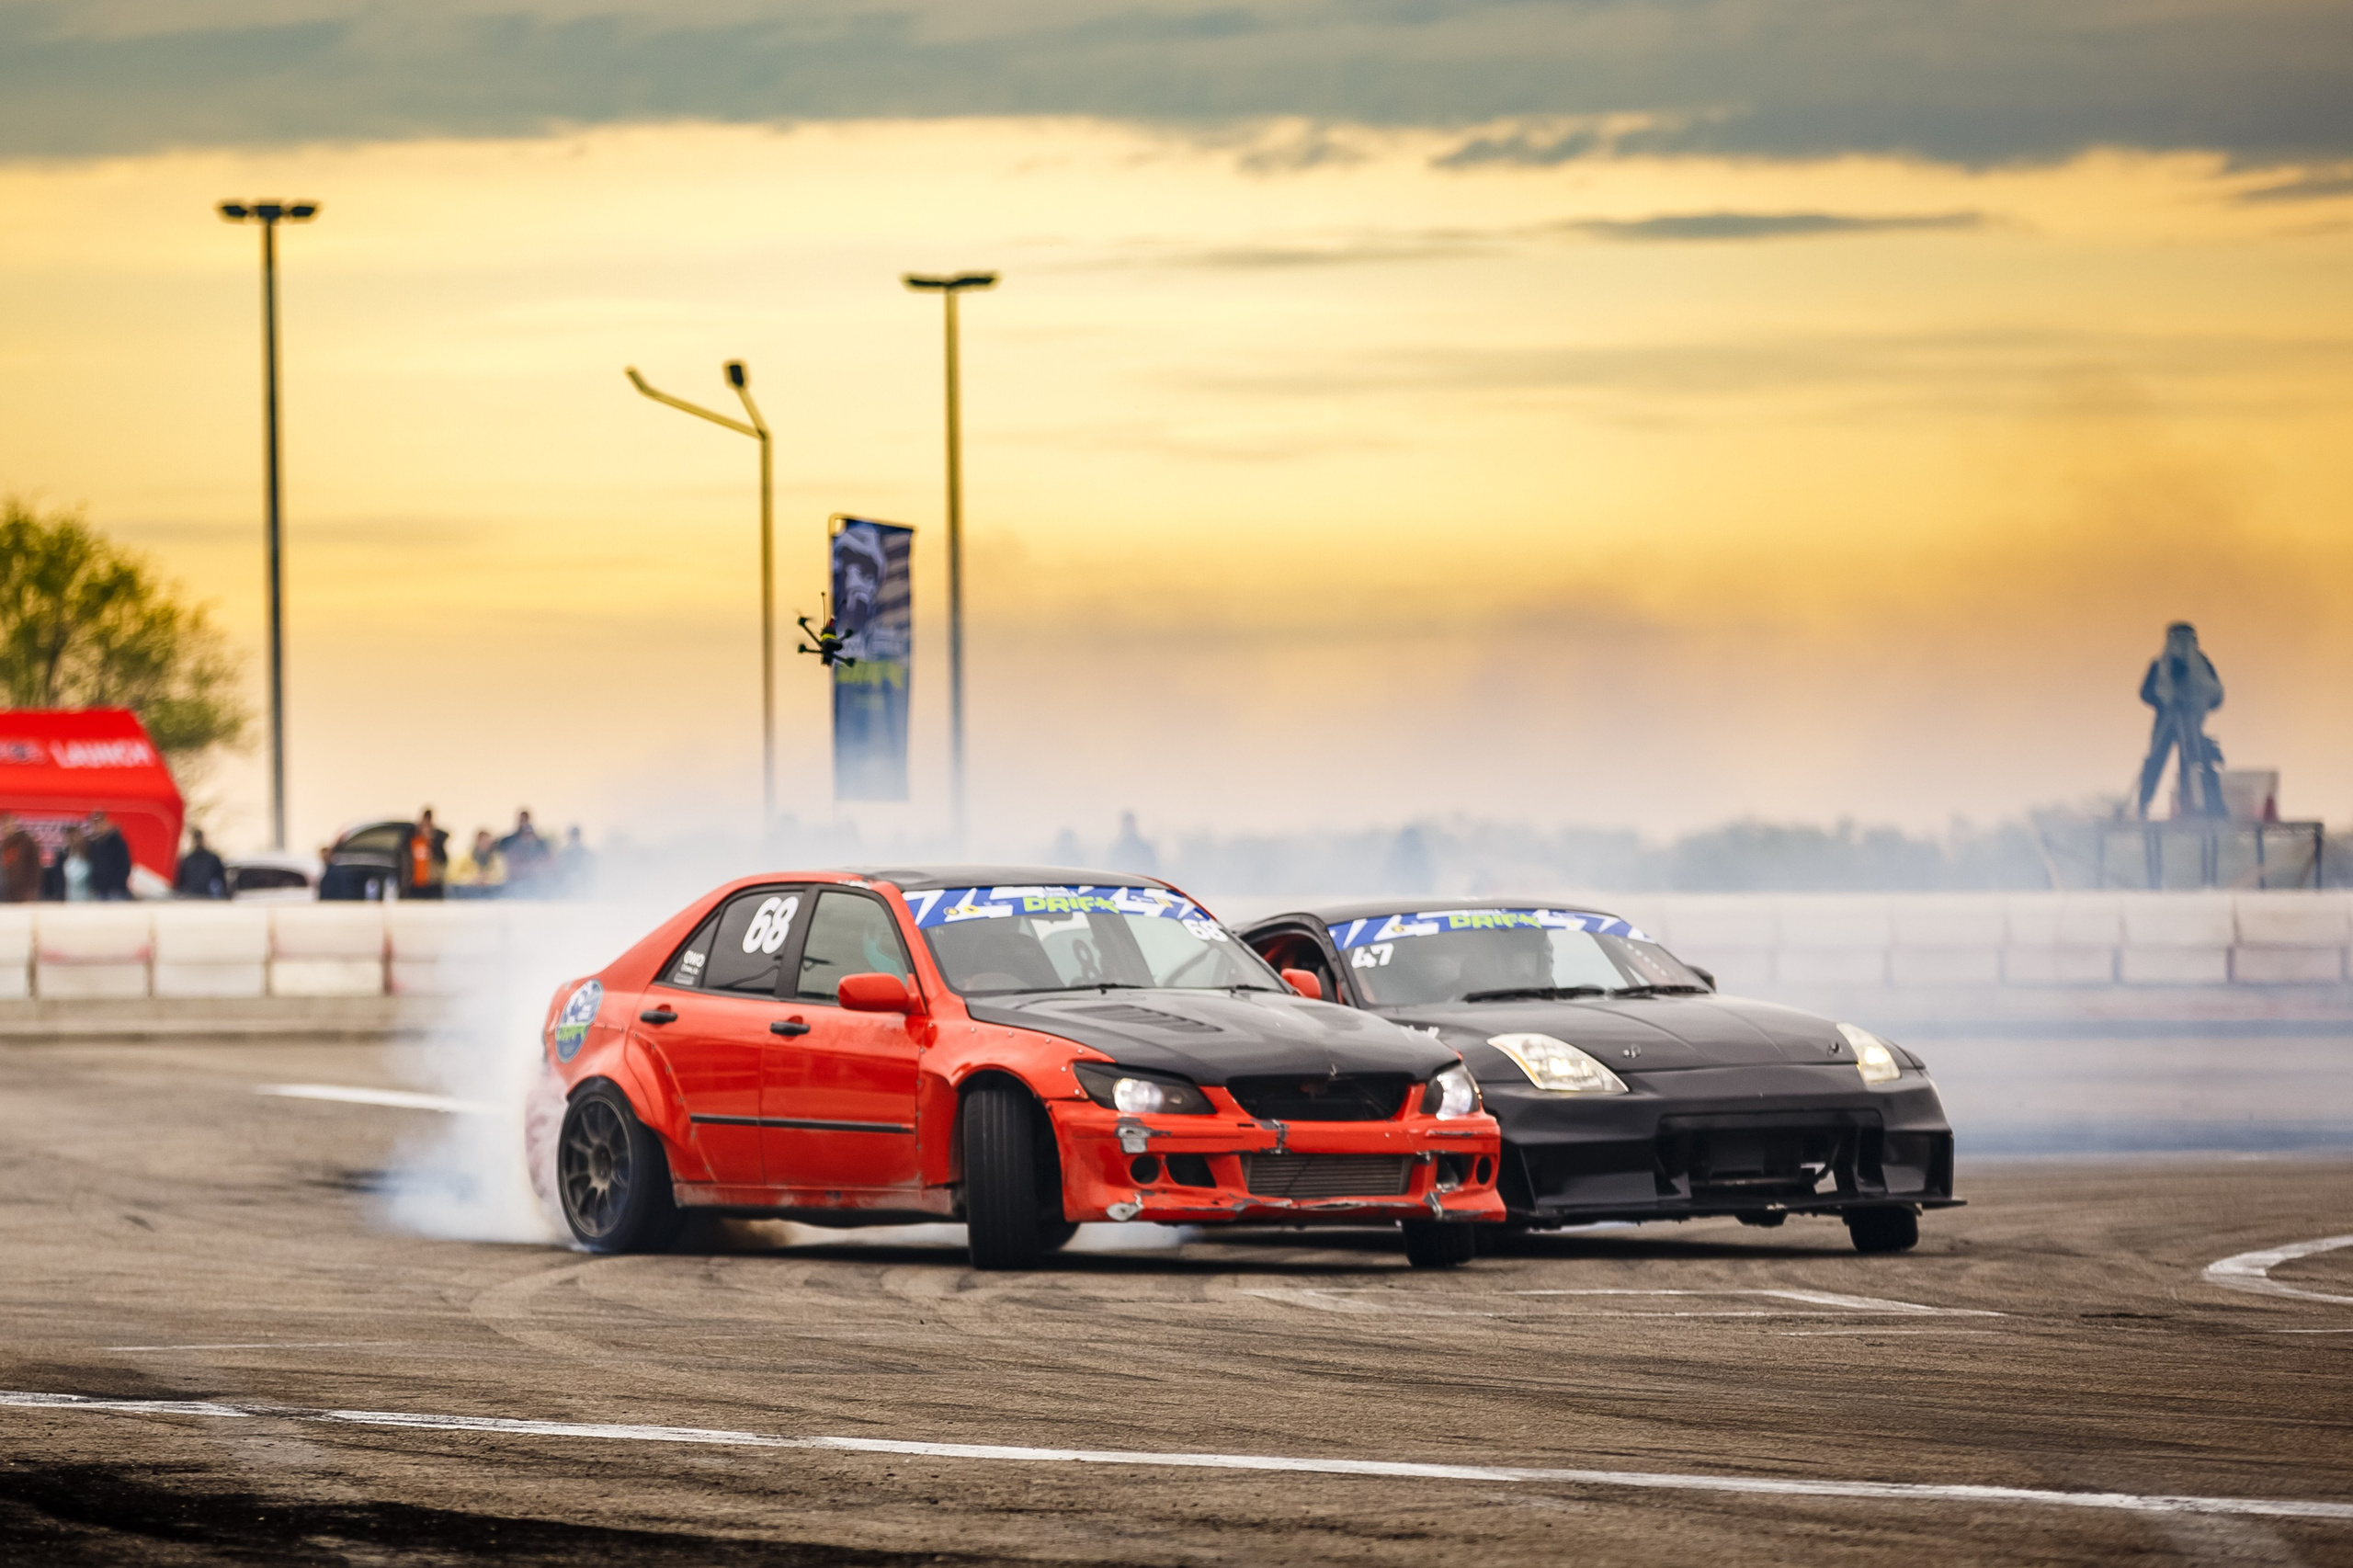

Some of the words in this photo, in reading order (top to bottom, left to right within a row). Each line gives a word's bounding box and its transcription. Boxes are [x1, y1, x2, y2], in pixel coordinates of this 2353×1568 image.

[1023, 896, 1120, 914] DRIFT
[742, 896, 799, 954] 68
[1182, 919, 1229, 942] 68
[1351, 943, 1394, 969] 47
